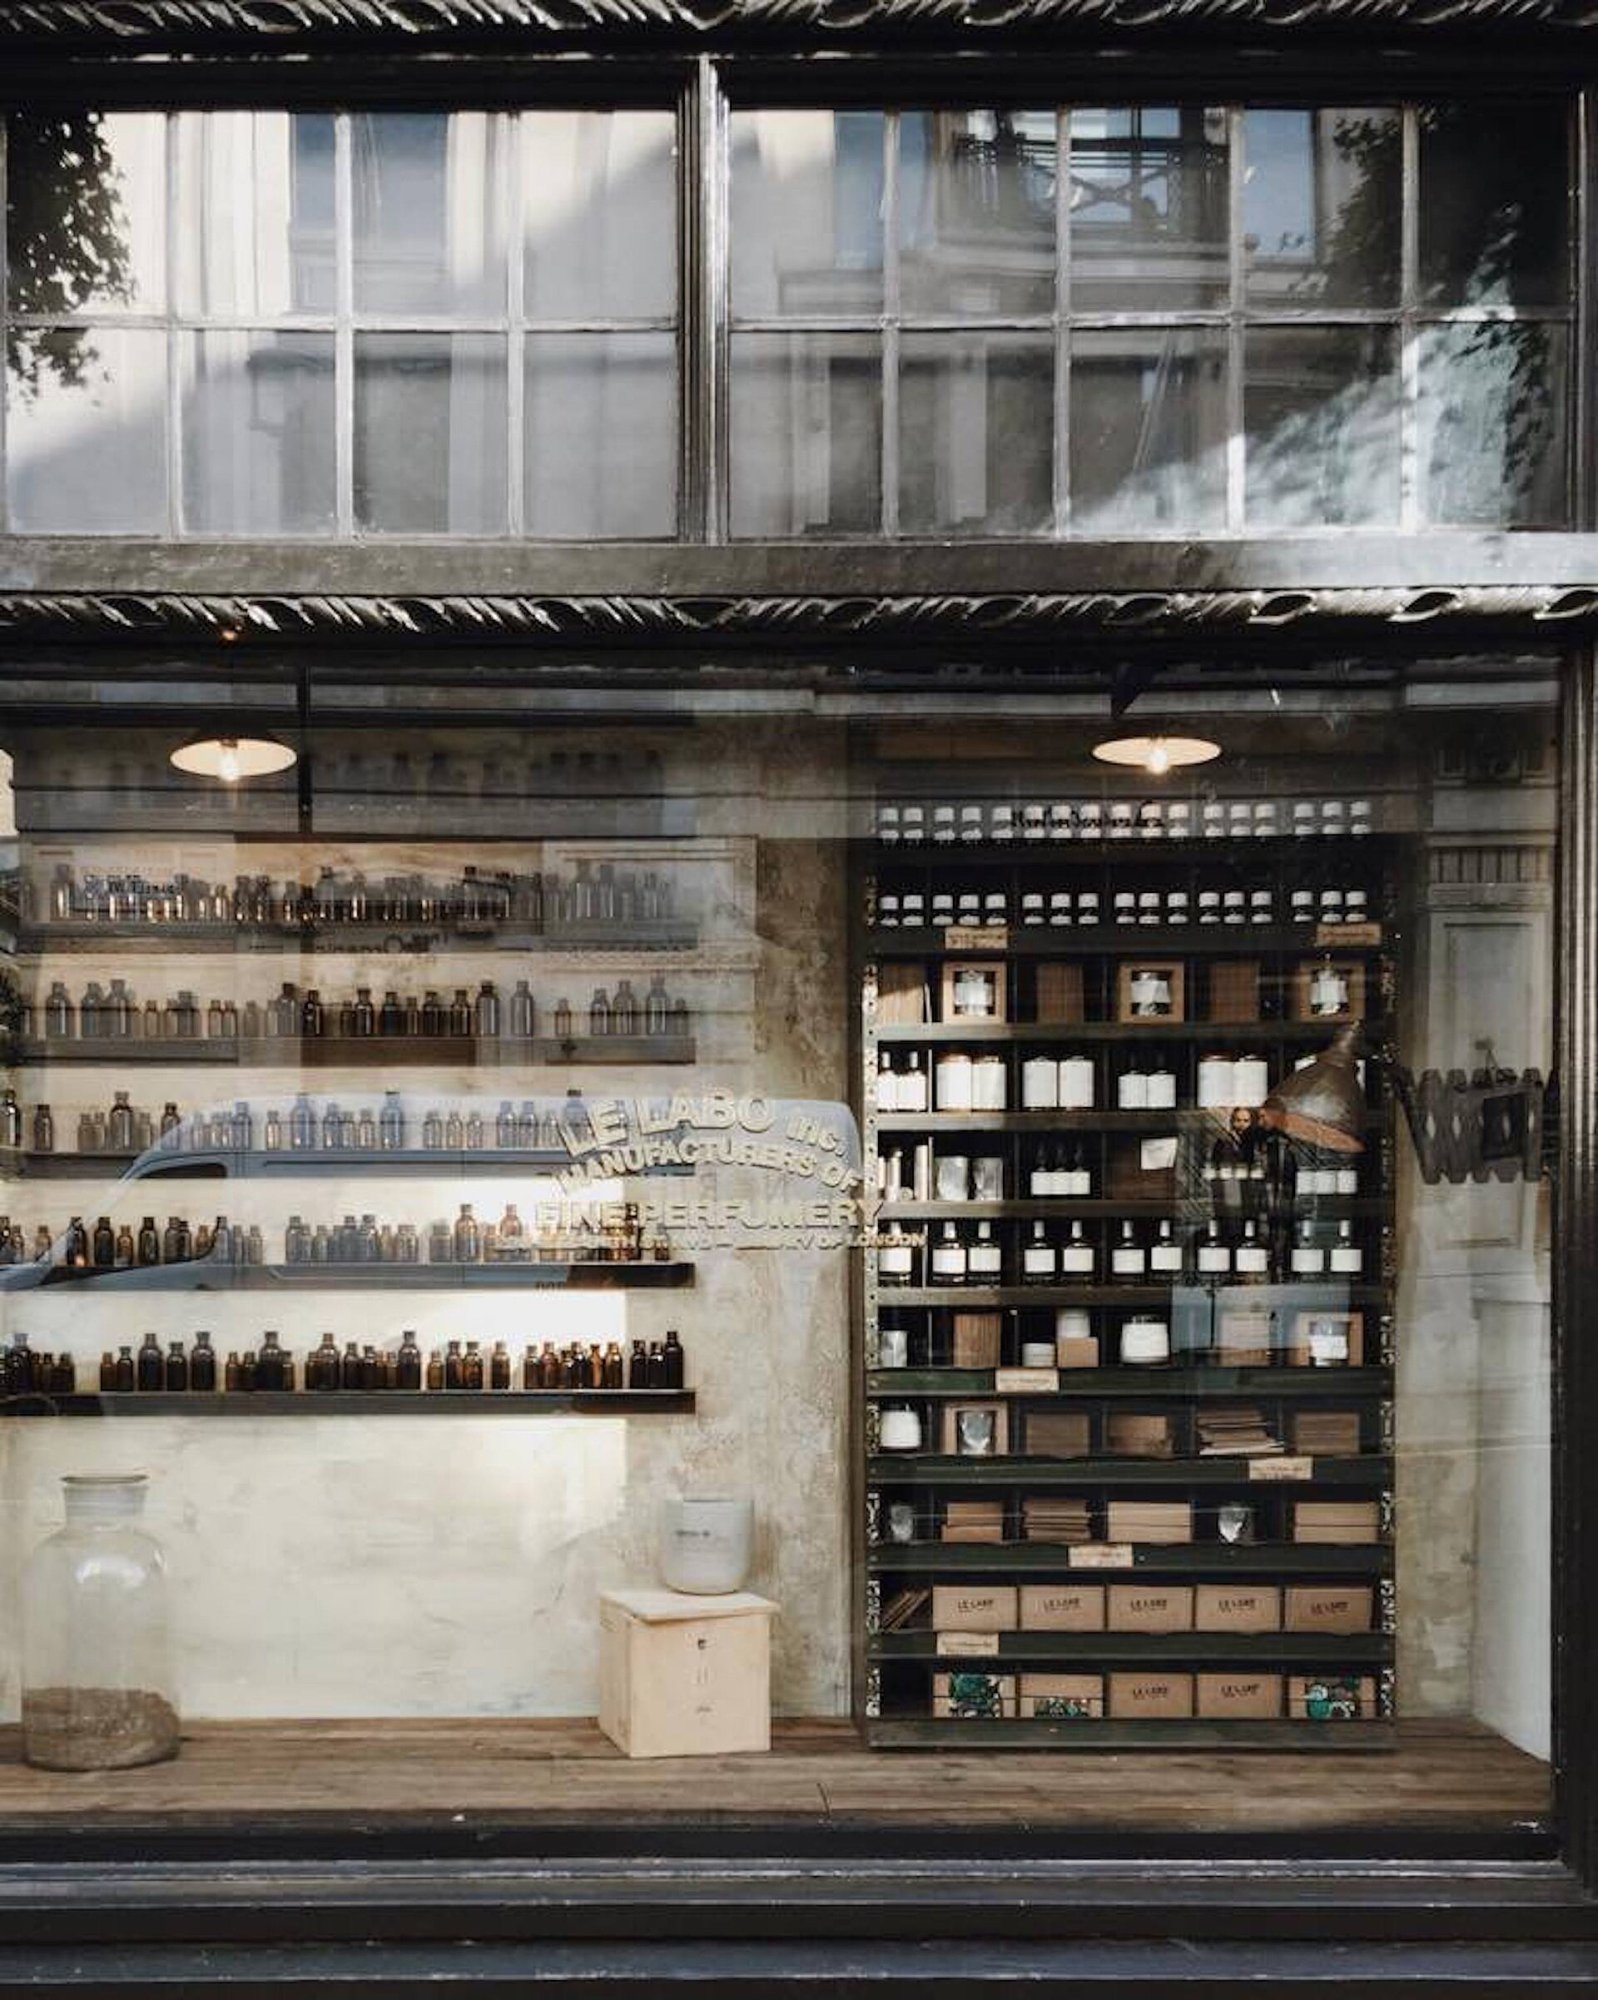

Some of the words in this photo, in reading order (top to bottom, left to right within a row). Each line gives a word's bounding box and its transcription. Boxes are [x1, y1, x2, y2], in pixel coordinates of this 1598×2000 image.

[556, 1099, 627, 1158] LE
[636, 1088, 775, 1135] LABO
[552, 1137, 818, 1198] MANUFACTURERS
[819, 1154, 862, 1193] OF
[535, 1198, 629, 1230] FINE
[637, 1197, 884, 1230] PERFUMERY
